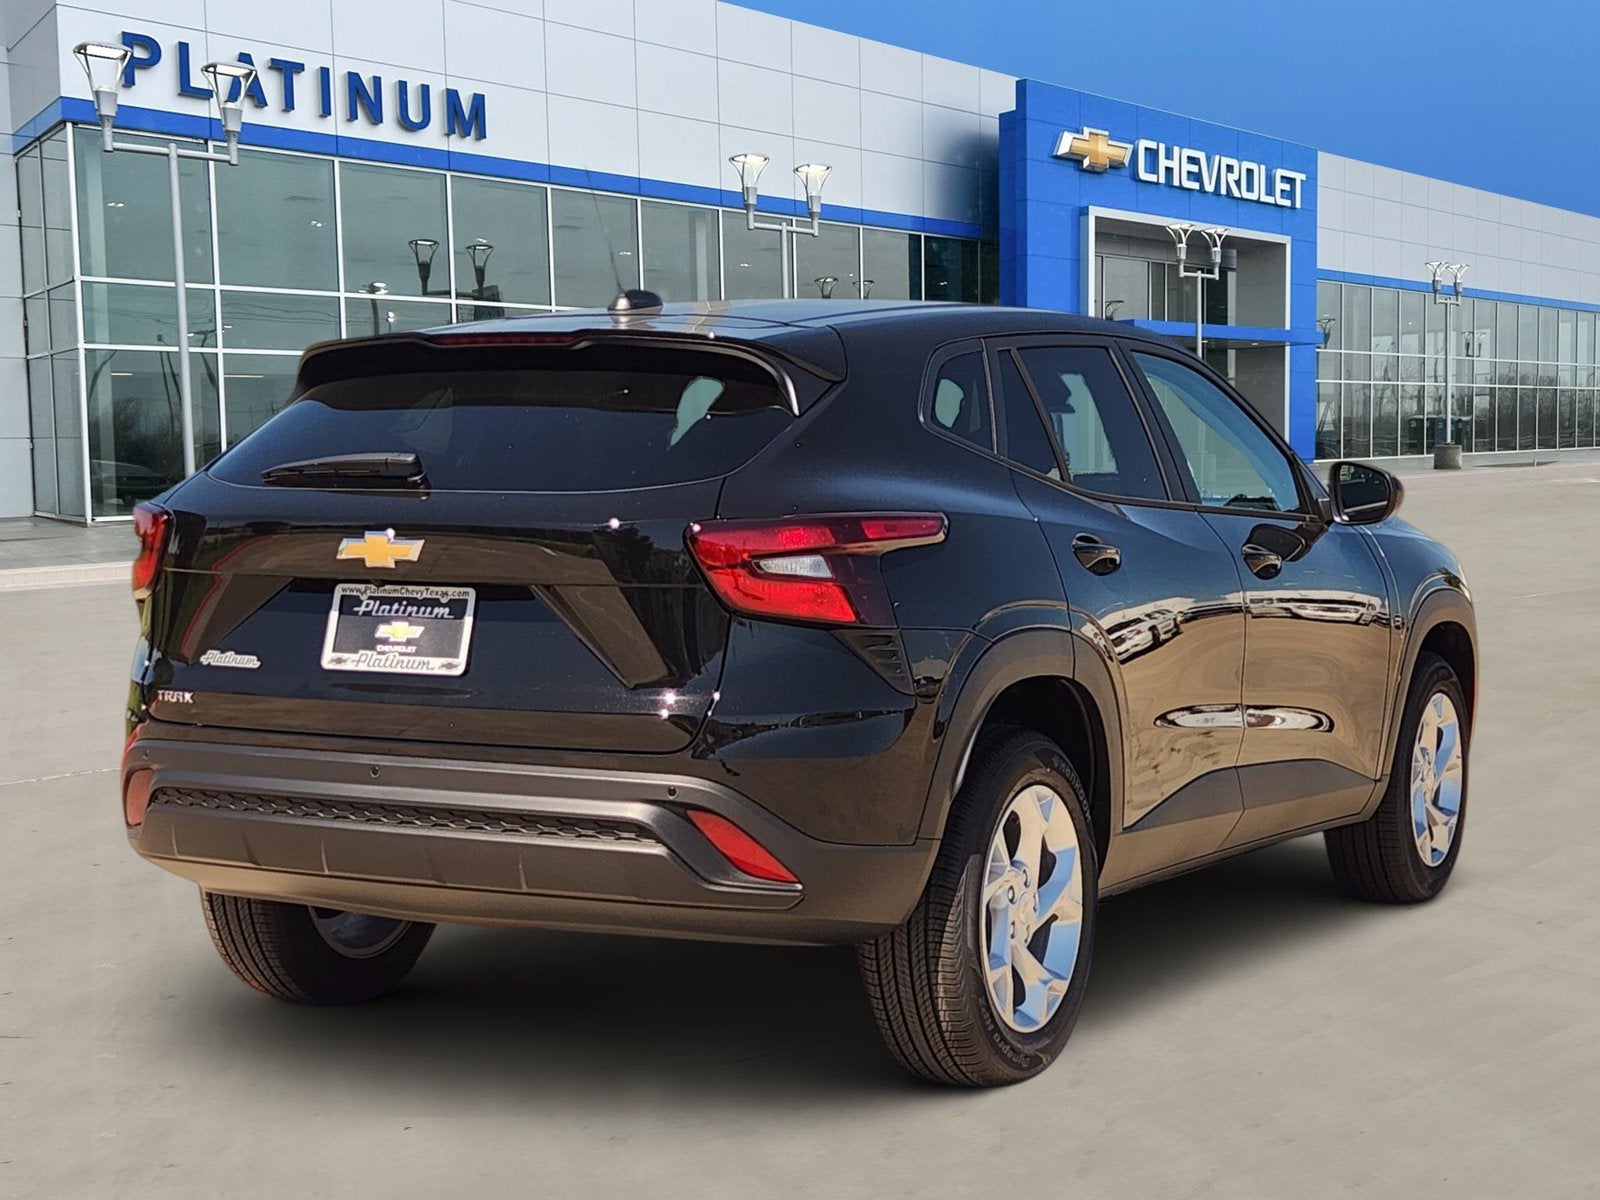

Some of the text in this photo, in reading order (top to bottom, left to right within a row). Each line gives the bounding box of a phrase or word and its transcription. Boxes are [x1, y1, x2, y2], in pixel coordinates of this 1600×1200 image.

[121, 31, 488, 141] PLATINUM
[1135, 138, 1306, 209] CHEVROLET
[353, 600, 454, 618] Platinum
[201, 651, 260, 667] Platinum
[352, 652, 435, 671] Platinum
[157, 690, 194, 704] TRAX
